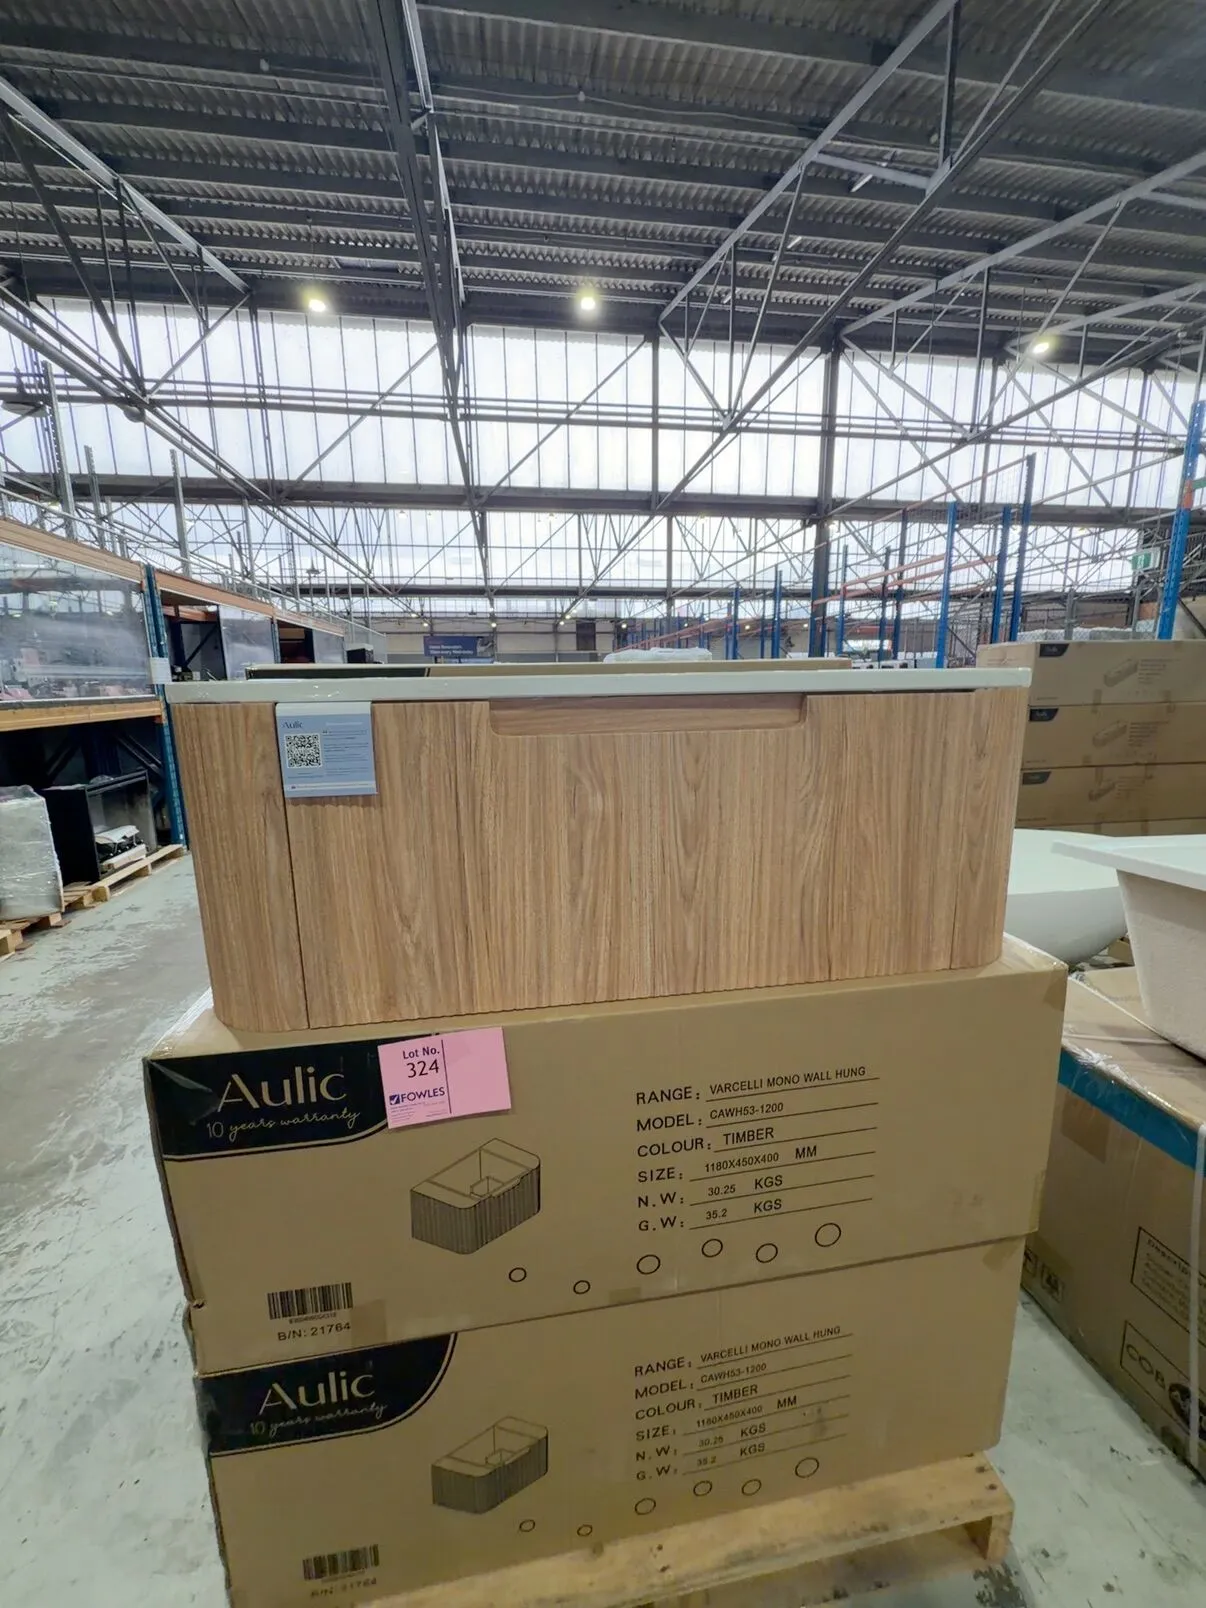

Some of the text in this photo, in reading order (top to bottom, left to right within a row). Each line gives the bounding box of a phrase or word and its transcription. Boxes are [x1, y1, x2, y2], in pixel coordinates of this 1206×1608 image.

[403, 1046, 440, 1060] Lot No.
[406, 1058, 440, 1078] 324
[218, 1066, 347, 1113] Aulic
[709, 1079, 763, 1095] VARCELLI
[767, 1074, 800, 1087] MONO
[804, 1070, 832, 1083] WALL
[835, 1066, 866, 1079] HUNG
[400, 1087, 445, 1102] FOWLES
[709, 1102, 784, 1119] CAWH53-1200
[206, 1107, 361, 1142] 10 years warranty
[723, 1127, 774, 1145] TIMBER
[705, 1152, 779, 1172] 1180X450X400
[795, 1145, 817, 1159] MM
[708, 1184, 736, 1196] 30.25
[754, 1175, 783, 1190] KGS
[706, 1208, 728, 1220] 35.2
[754, 1198, 782, 1213] KGS
[277, 1322, 351, 1341] B/N: 21764
[700, 1346, 748, 1363] VARCELLI
[751, 1338, 781, 1352] MONO
[784, 1332, 809, 1344] WALL
[813, 1325, 841, 1339] HUNG
[700, 1362, 767, 1384] CAWH53-1200
[259, 1371, 375, 1415] Aulic
[713, 1384, 758, 1404] TIMBER
[776, 1395, 797, 1409] MM
[250, 1420, 266, 1436] 10
[740, 1422, 766, 1437] KGS
[740, 1442, 765, 1457] KGS
